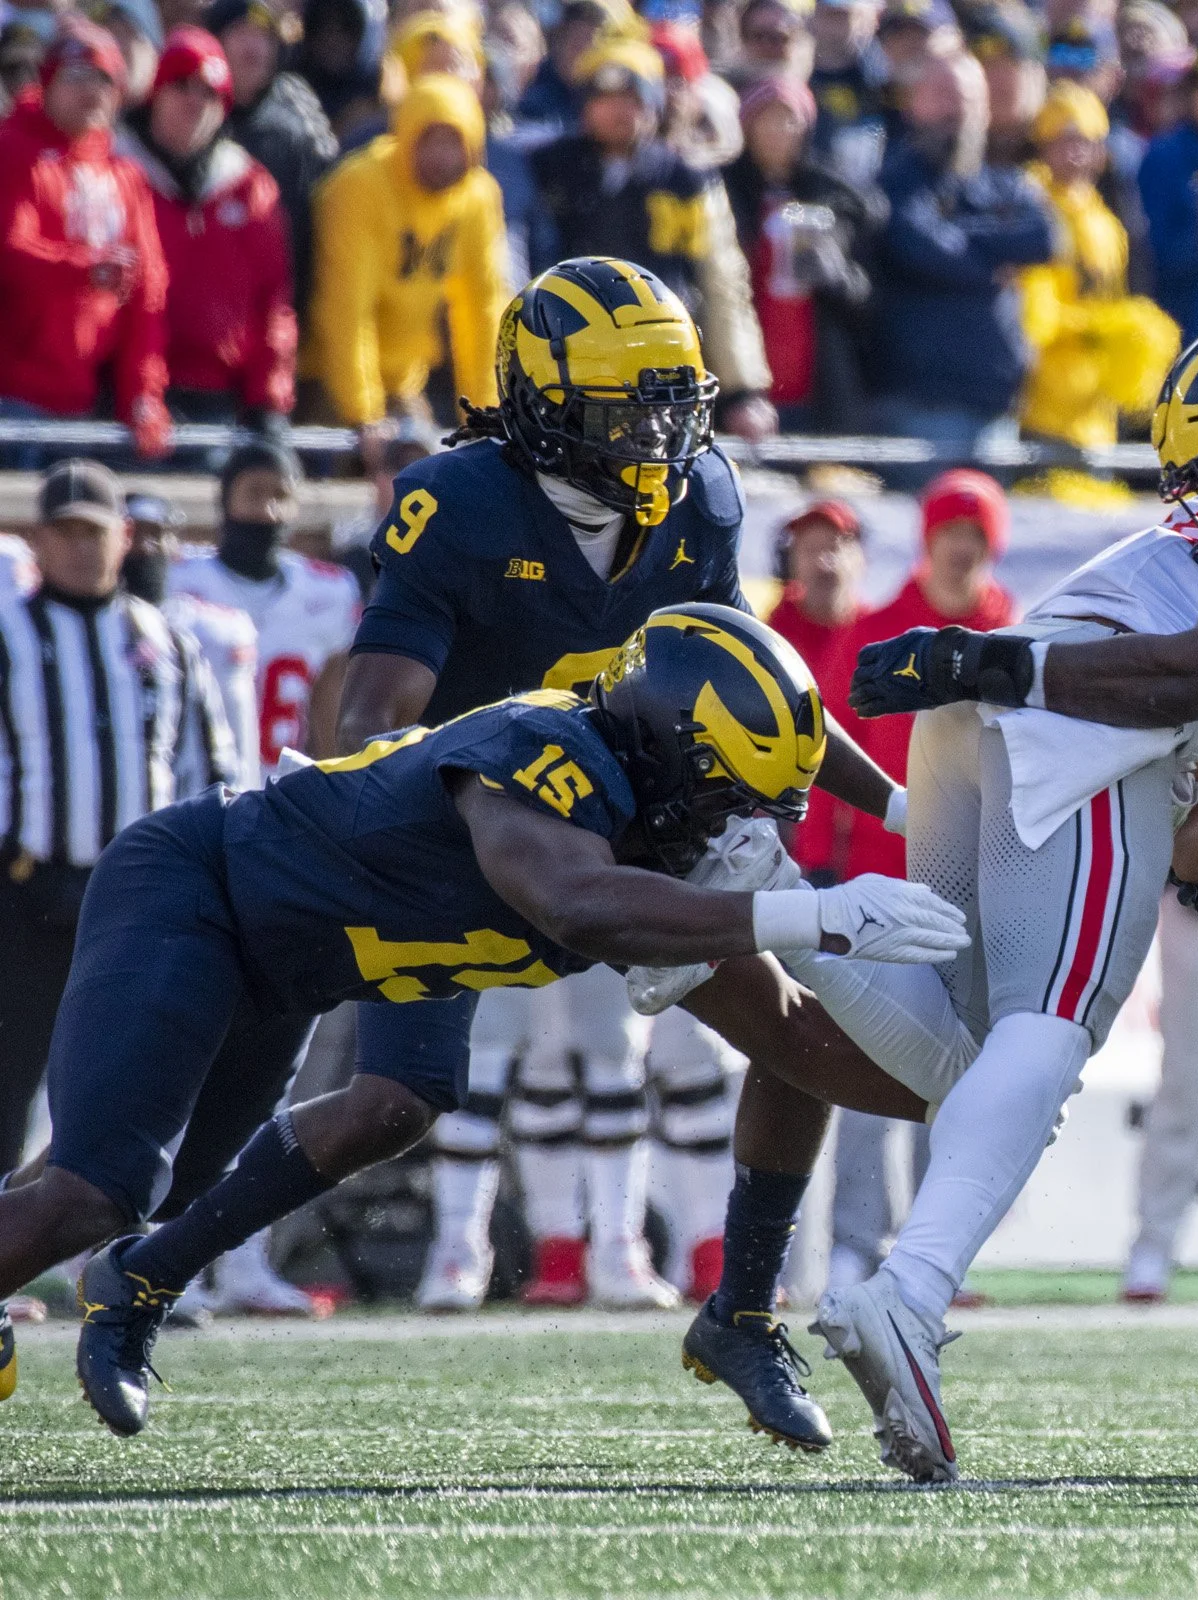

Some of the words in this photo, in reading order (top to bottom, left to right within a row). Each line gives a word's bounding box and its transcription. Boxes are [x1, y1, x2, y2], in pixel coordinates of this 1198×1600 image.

[386, 489, 438, 555] 9
[505, 558, 545, 580] BIG
[511, 744, 593, 818] 15
